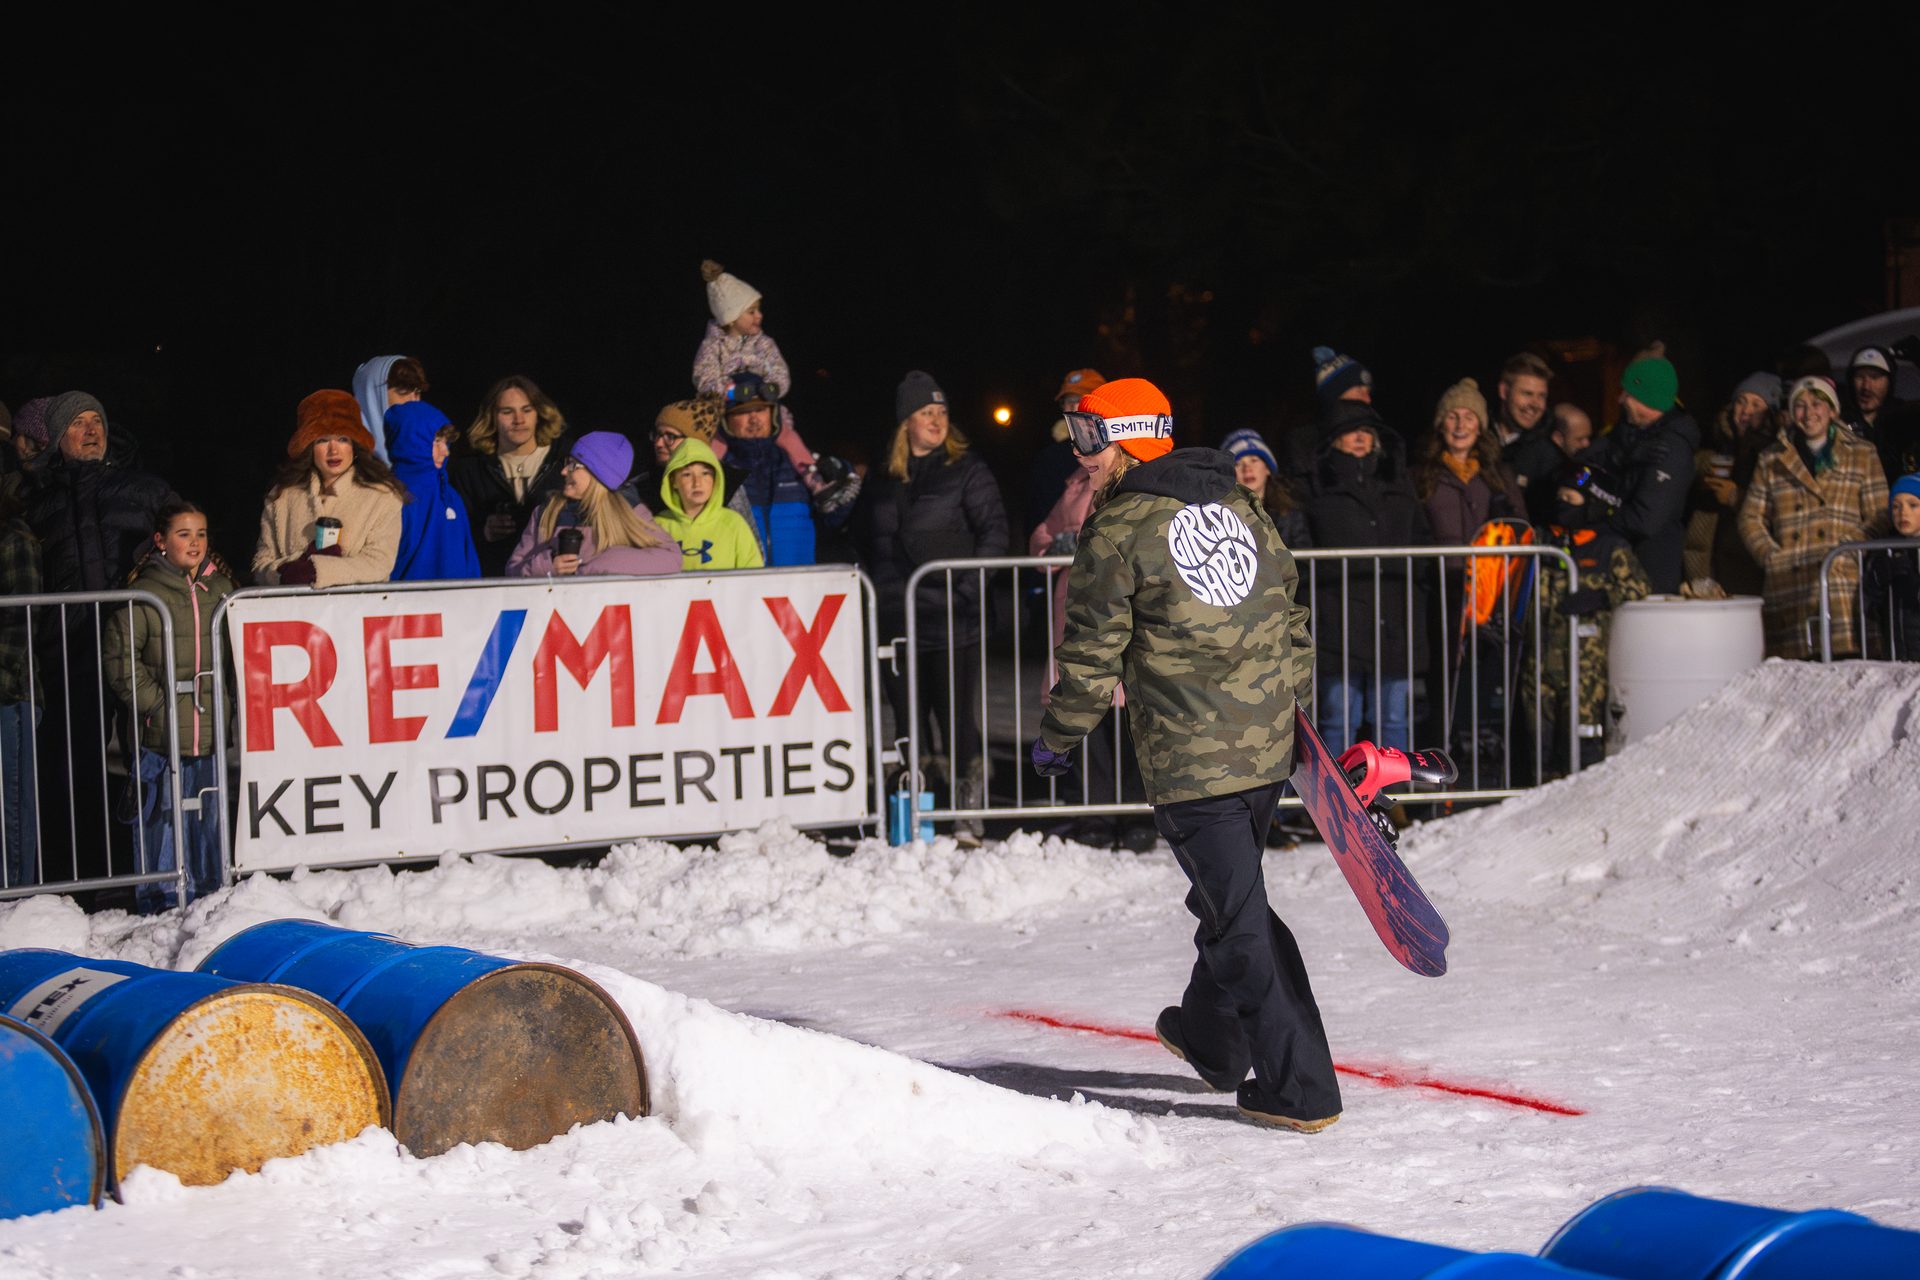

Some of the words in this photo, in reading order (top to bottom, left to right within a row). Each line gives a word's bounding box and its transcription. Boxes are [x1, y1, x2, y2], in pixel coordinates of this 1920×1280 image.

[1110, 421, 1154, 434] SMITH
[1174, 540, 1258, 607] SHRED
[243, 594, 852, 752] RE/MAX
[248, 771, 398, 839] KEY
[428, 739, 855, 825] PROPERTIES
